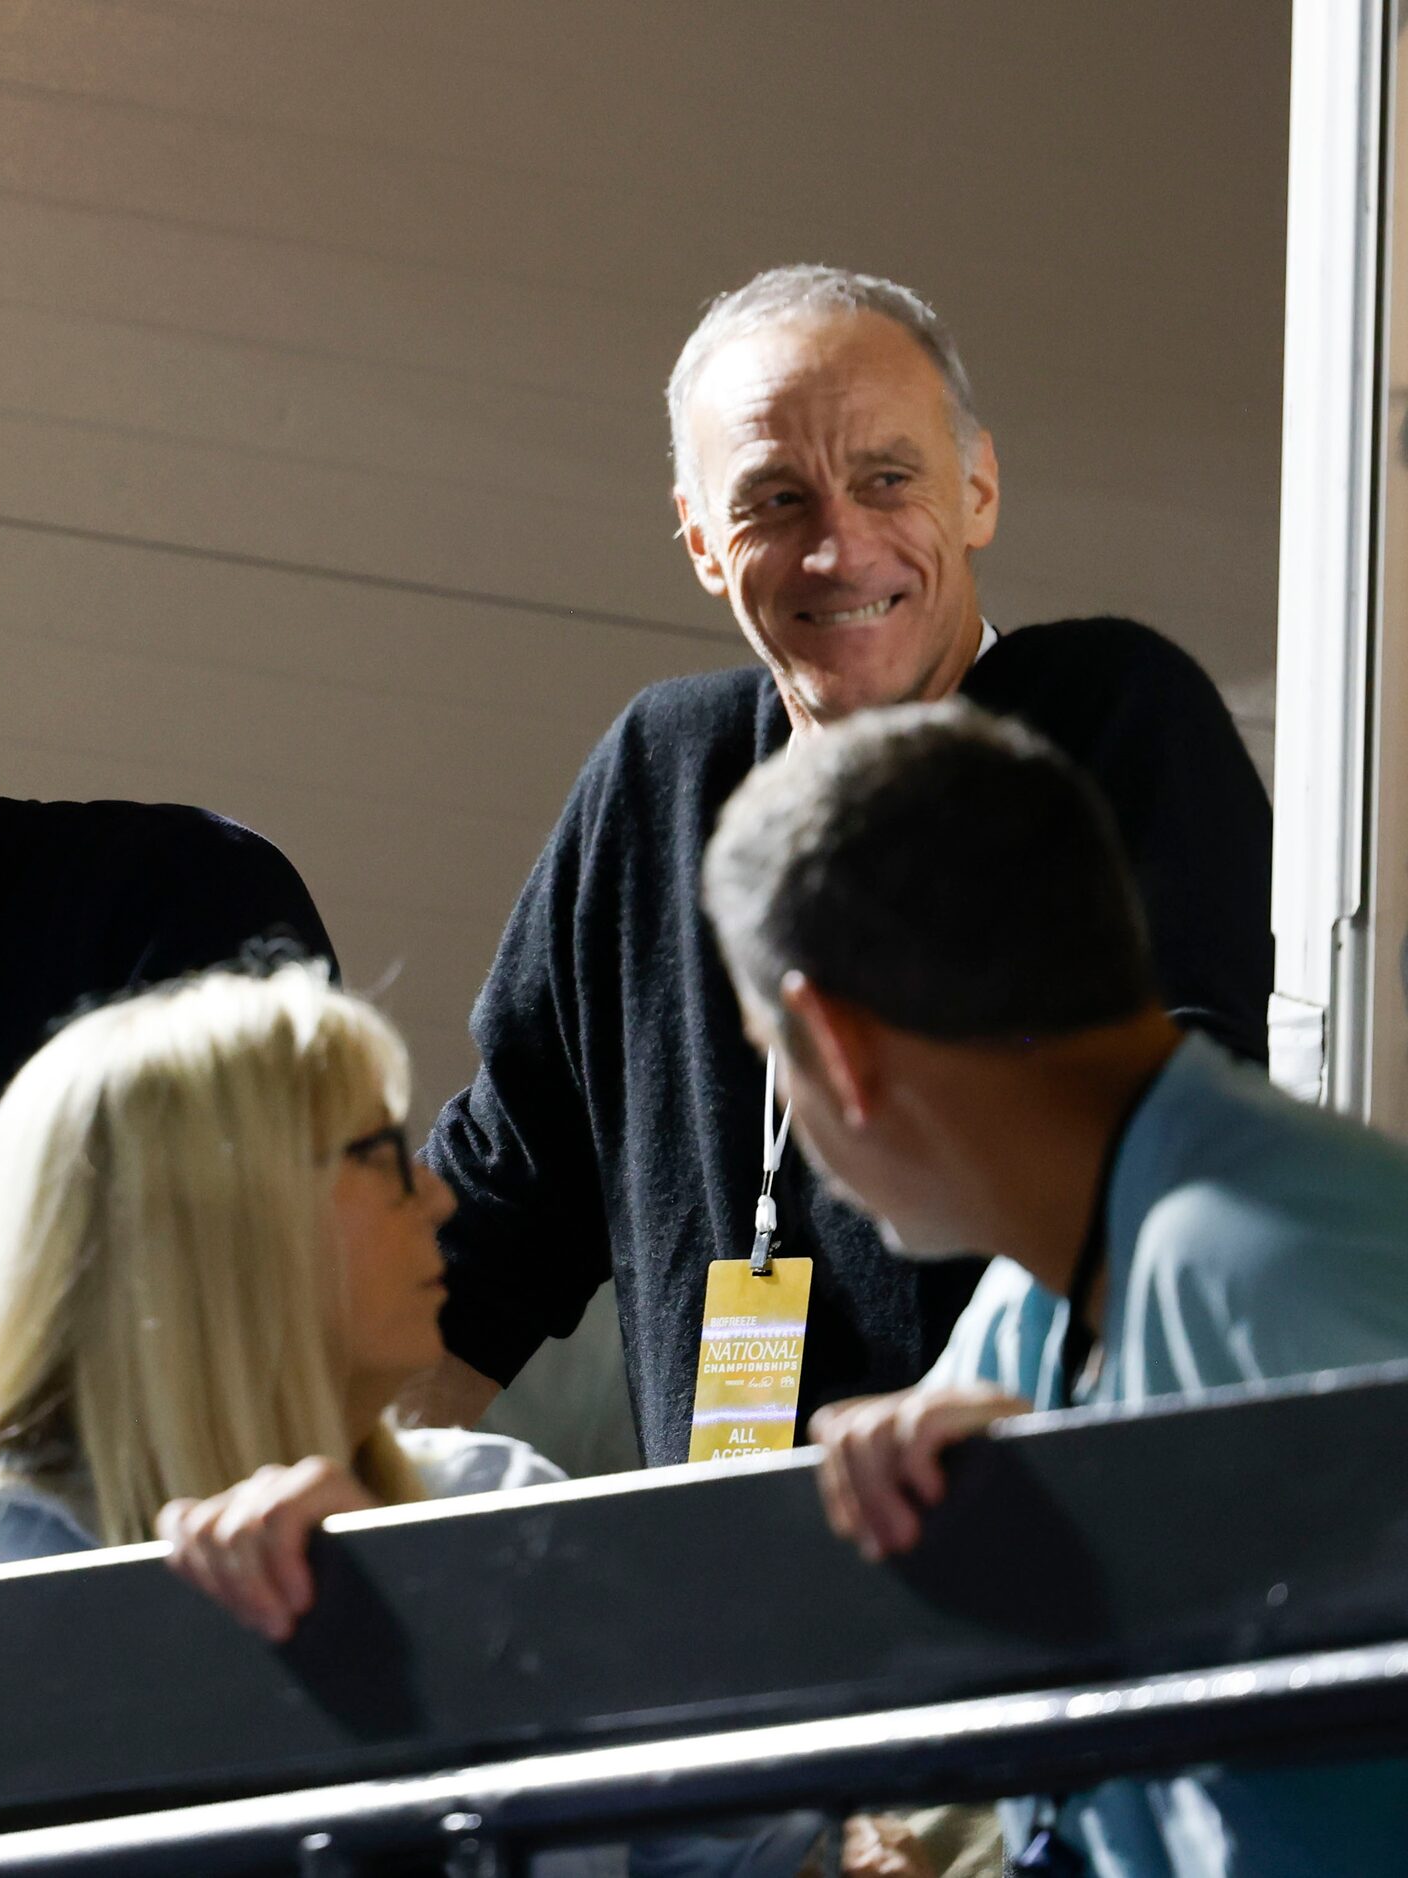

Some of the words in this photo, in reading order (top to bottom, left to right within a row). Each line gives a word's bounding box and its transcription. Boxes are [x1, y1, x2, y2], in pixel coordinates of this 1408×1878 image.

[705, 1341, 799, 1361] NATIONAL
[704, 1361, 797, 1373] CHAMPIONSHIPS
[729, 1428, 756, 1443] ALL
